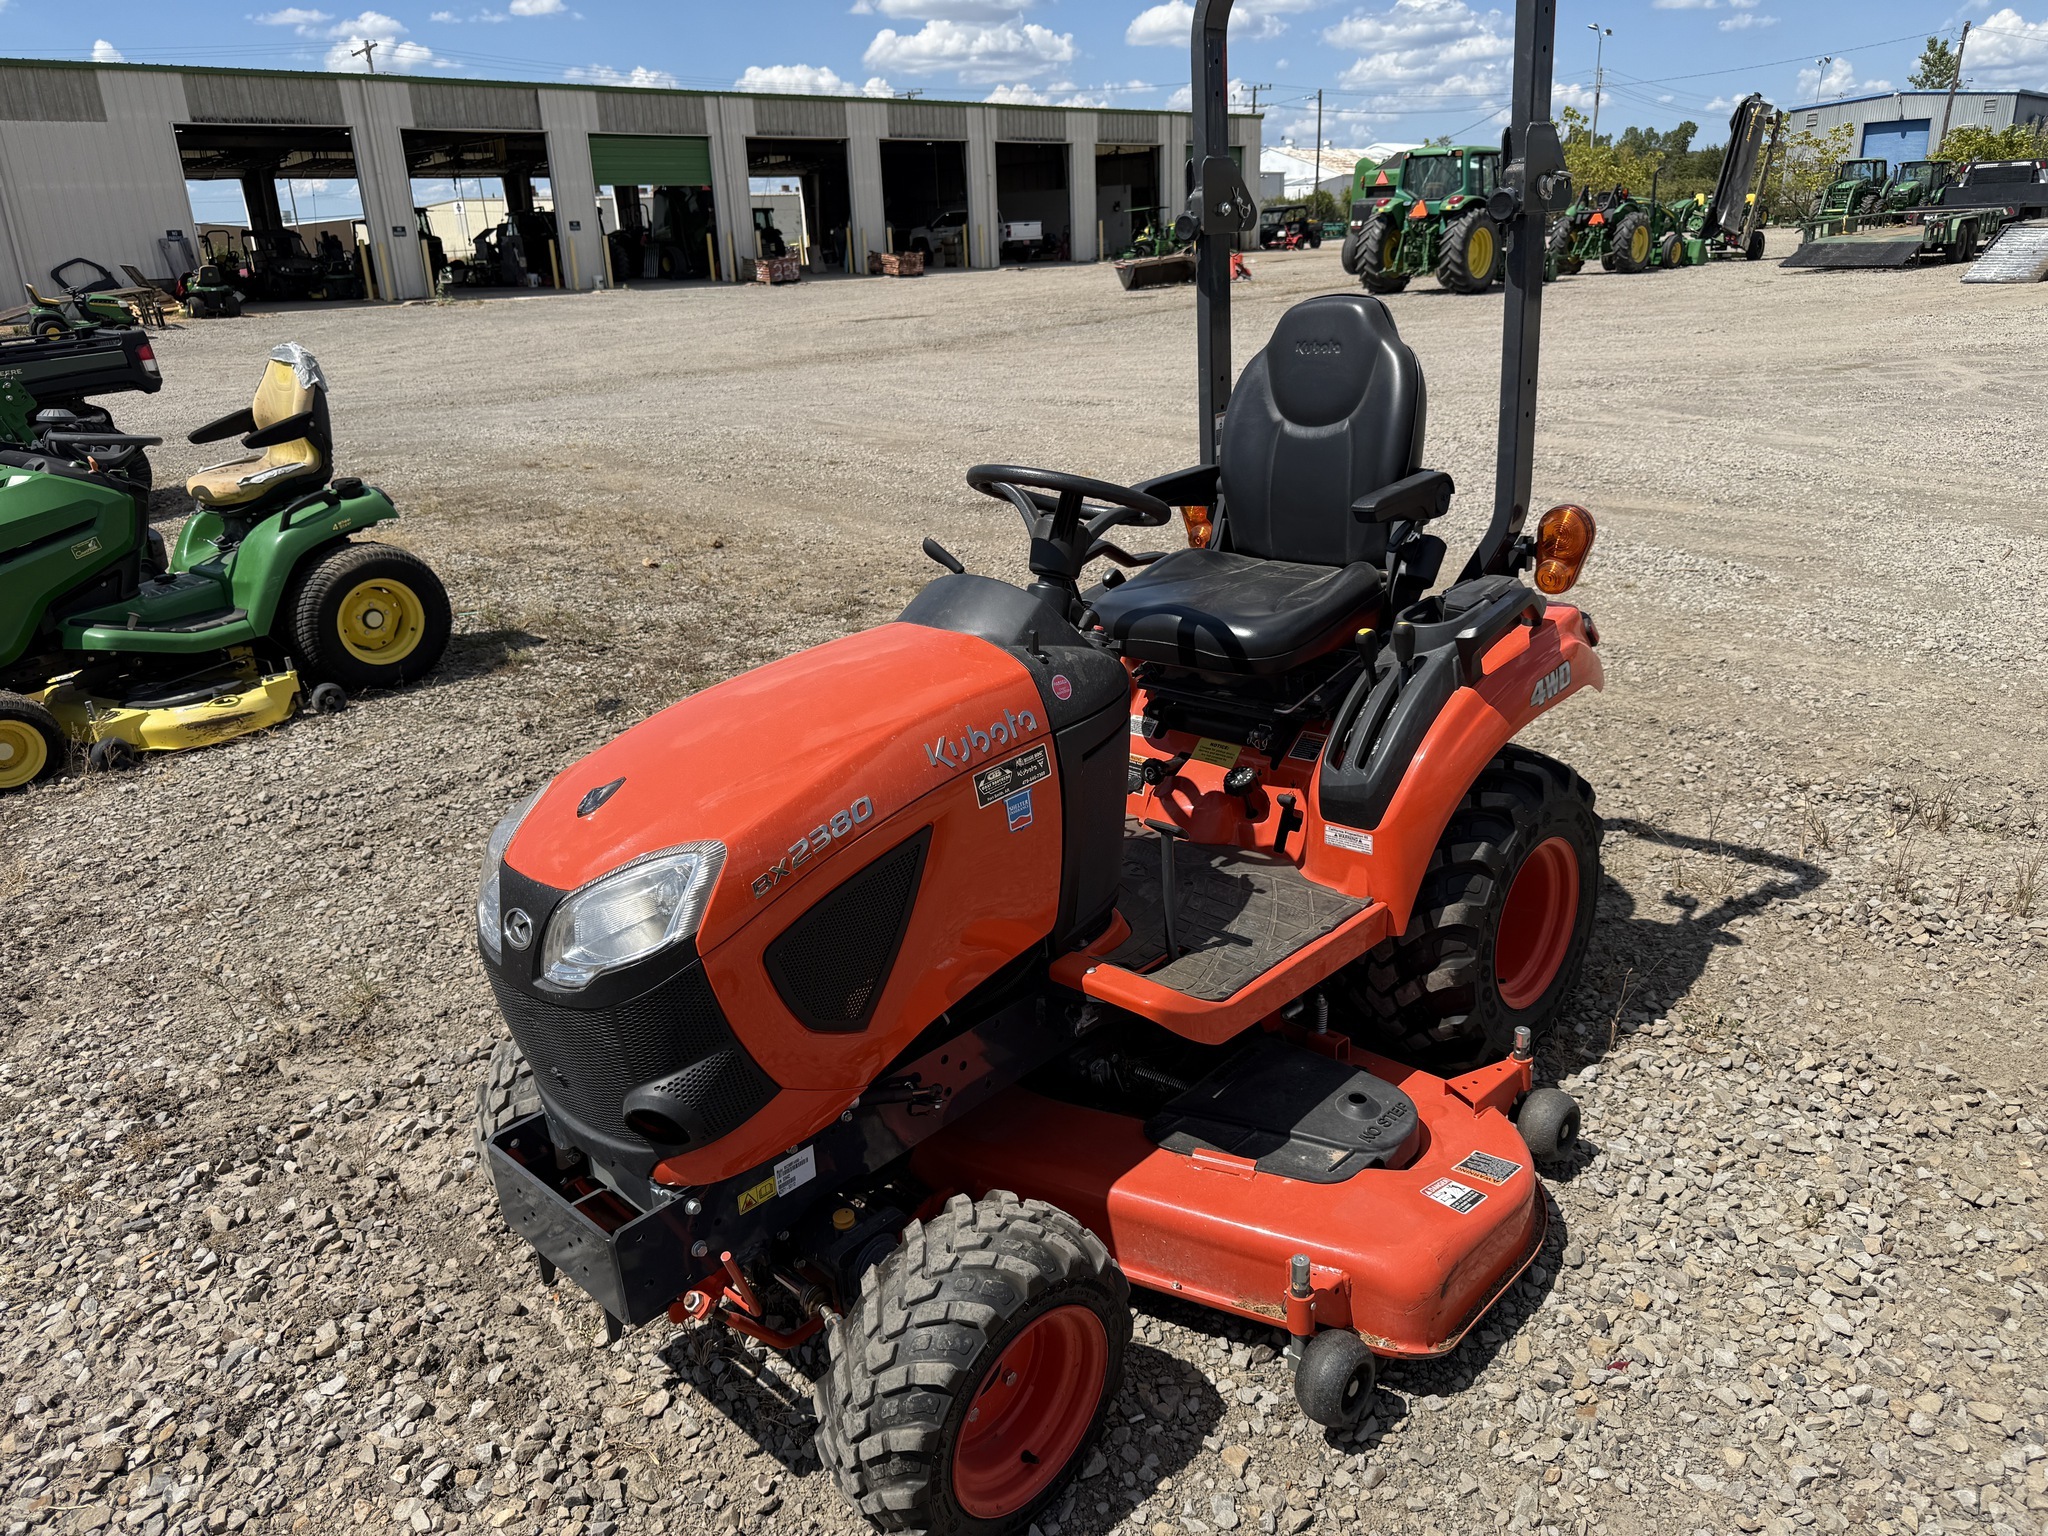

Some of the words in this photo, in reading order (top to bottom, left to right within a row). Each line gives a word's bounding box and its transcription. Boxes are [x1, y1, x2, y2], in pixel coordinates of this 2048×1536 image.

[1295, 340, 1341, 355] Kubota
[1530, 660, 1571, 707] 4WD
[923, 708, 1038, 768] Kubota
[1016, 764, 1037, 777] Kubota
[1009, 800, 1029, 812] SHELTER
[751, 795, 873, 900] BX2380
[1358, 1126, 1382, 1144] NO
[1376, 1102, 1408, 1128] STEP
[1426, 1179, 1449, 1195] DANGER
